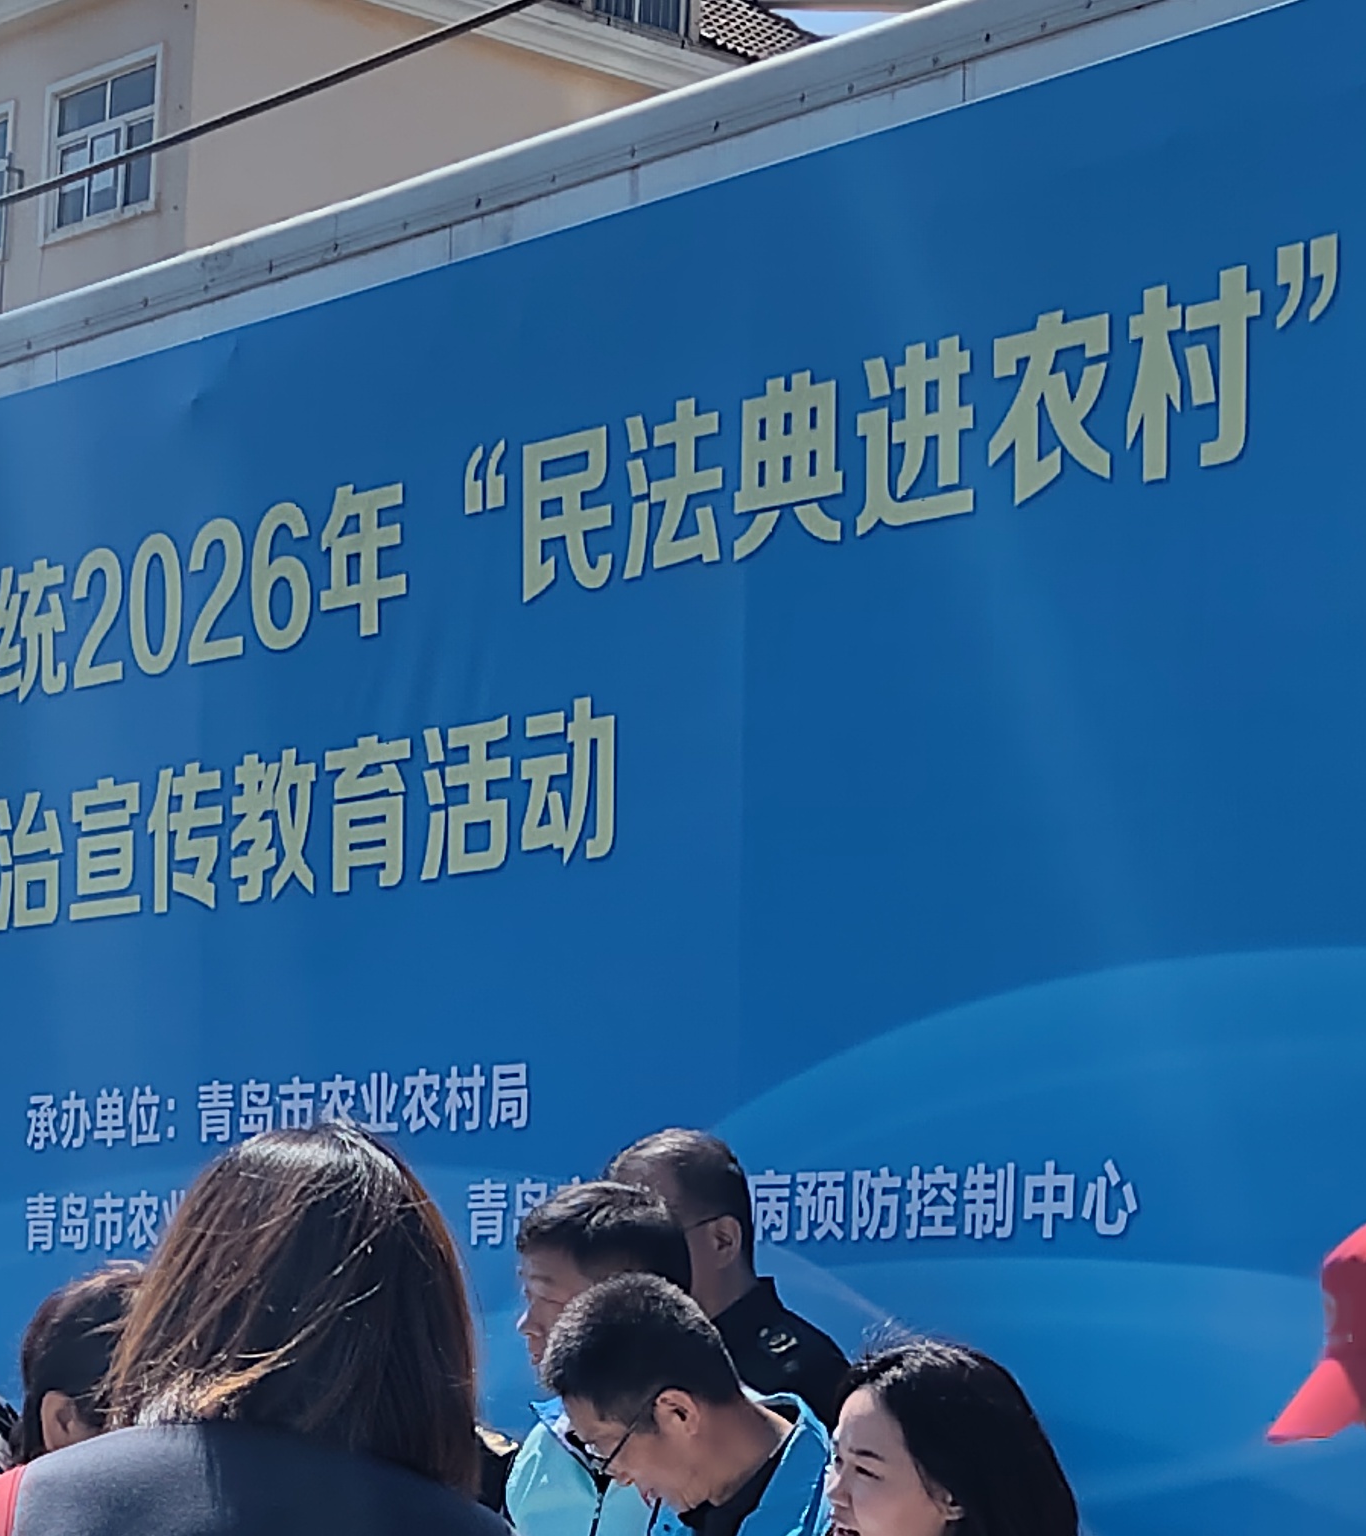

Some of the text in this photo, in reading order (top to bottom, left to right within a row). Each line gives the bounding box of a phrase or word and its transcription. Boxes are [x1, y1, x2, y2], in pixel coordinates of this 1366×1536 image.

[25, 1062, 529, 1152] 承办单位：青岛市农业农村局
